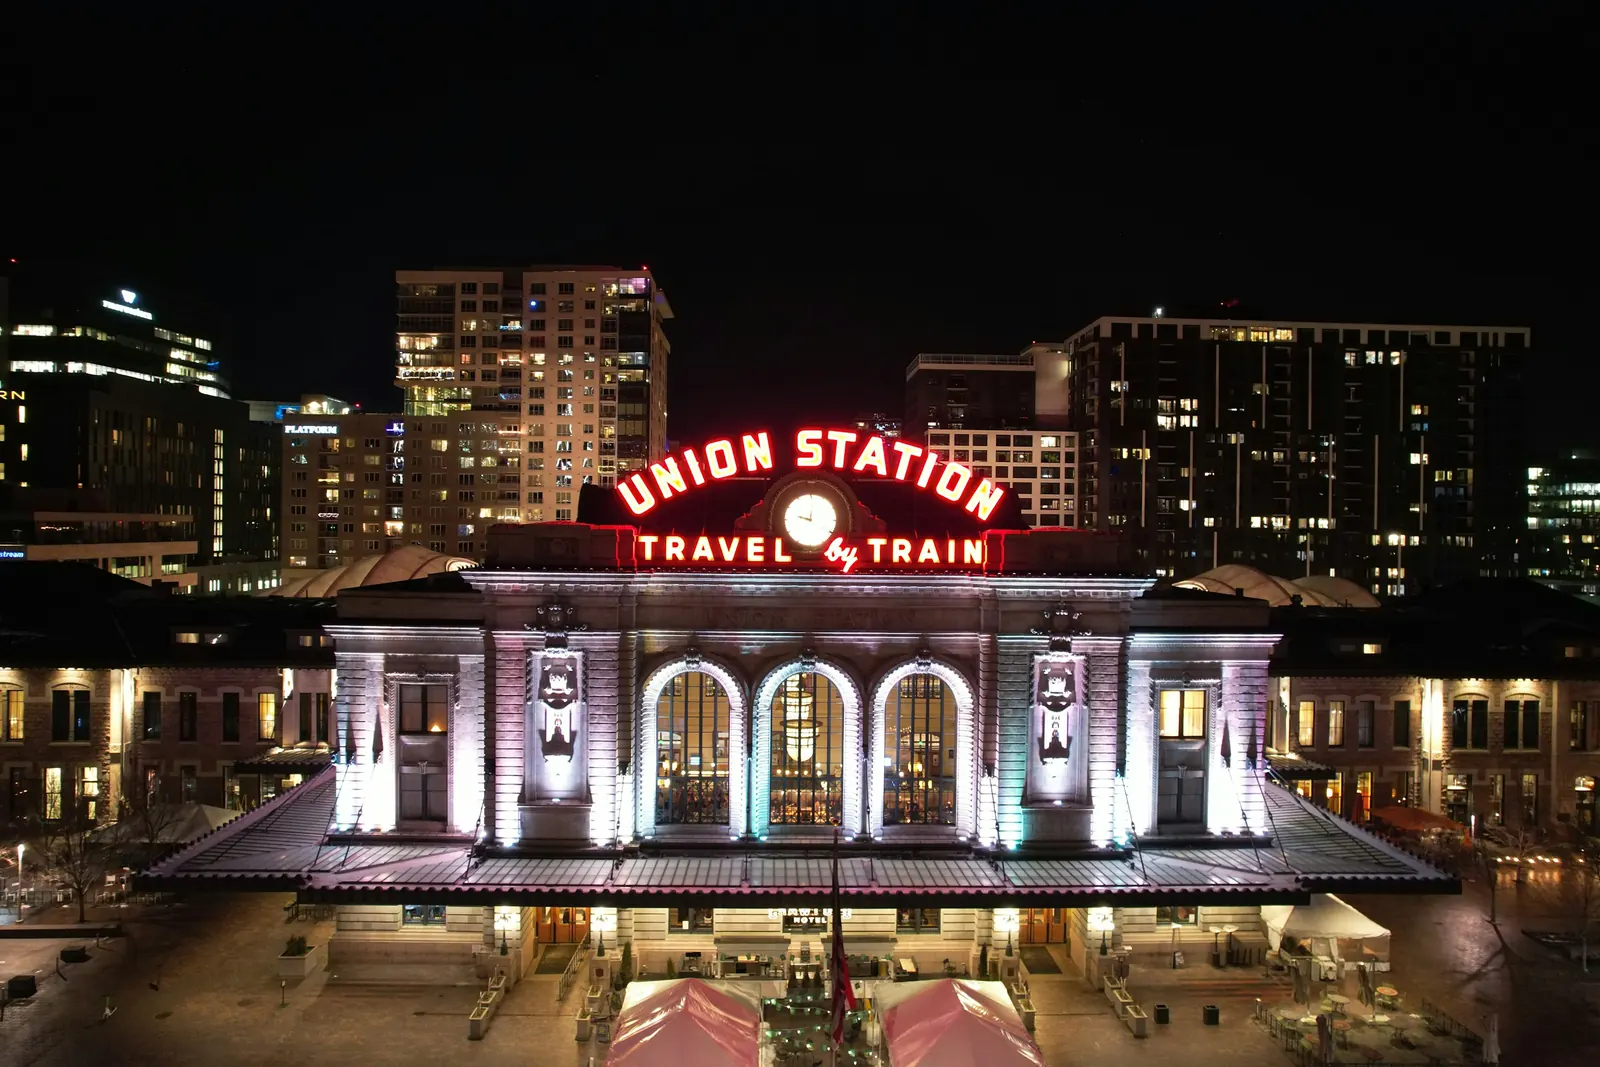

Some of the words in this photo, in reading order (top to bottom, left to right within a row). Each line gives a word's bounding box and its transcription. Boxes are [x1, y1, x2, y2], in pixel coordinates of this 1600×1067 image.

[284, 425, 338, 435] PLATFORM
[616, 431, 773, 516] UNION
[795, 428, 1008, 522] STATION
[638, 535, 792, 563] TRAVEL
[823, 537, 859, 574] by
[867, 537, 983, 565] TRAIN
